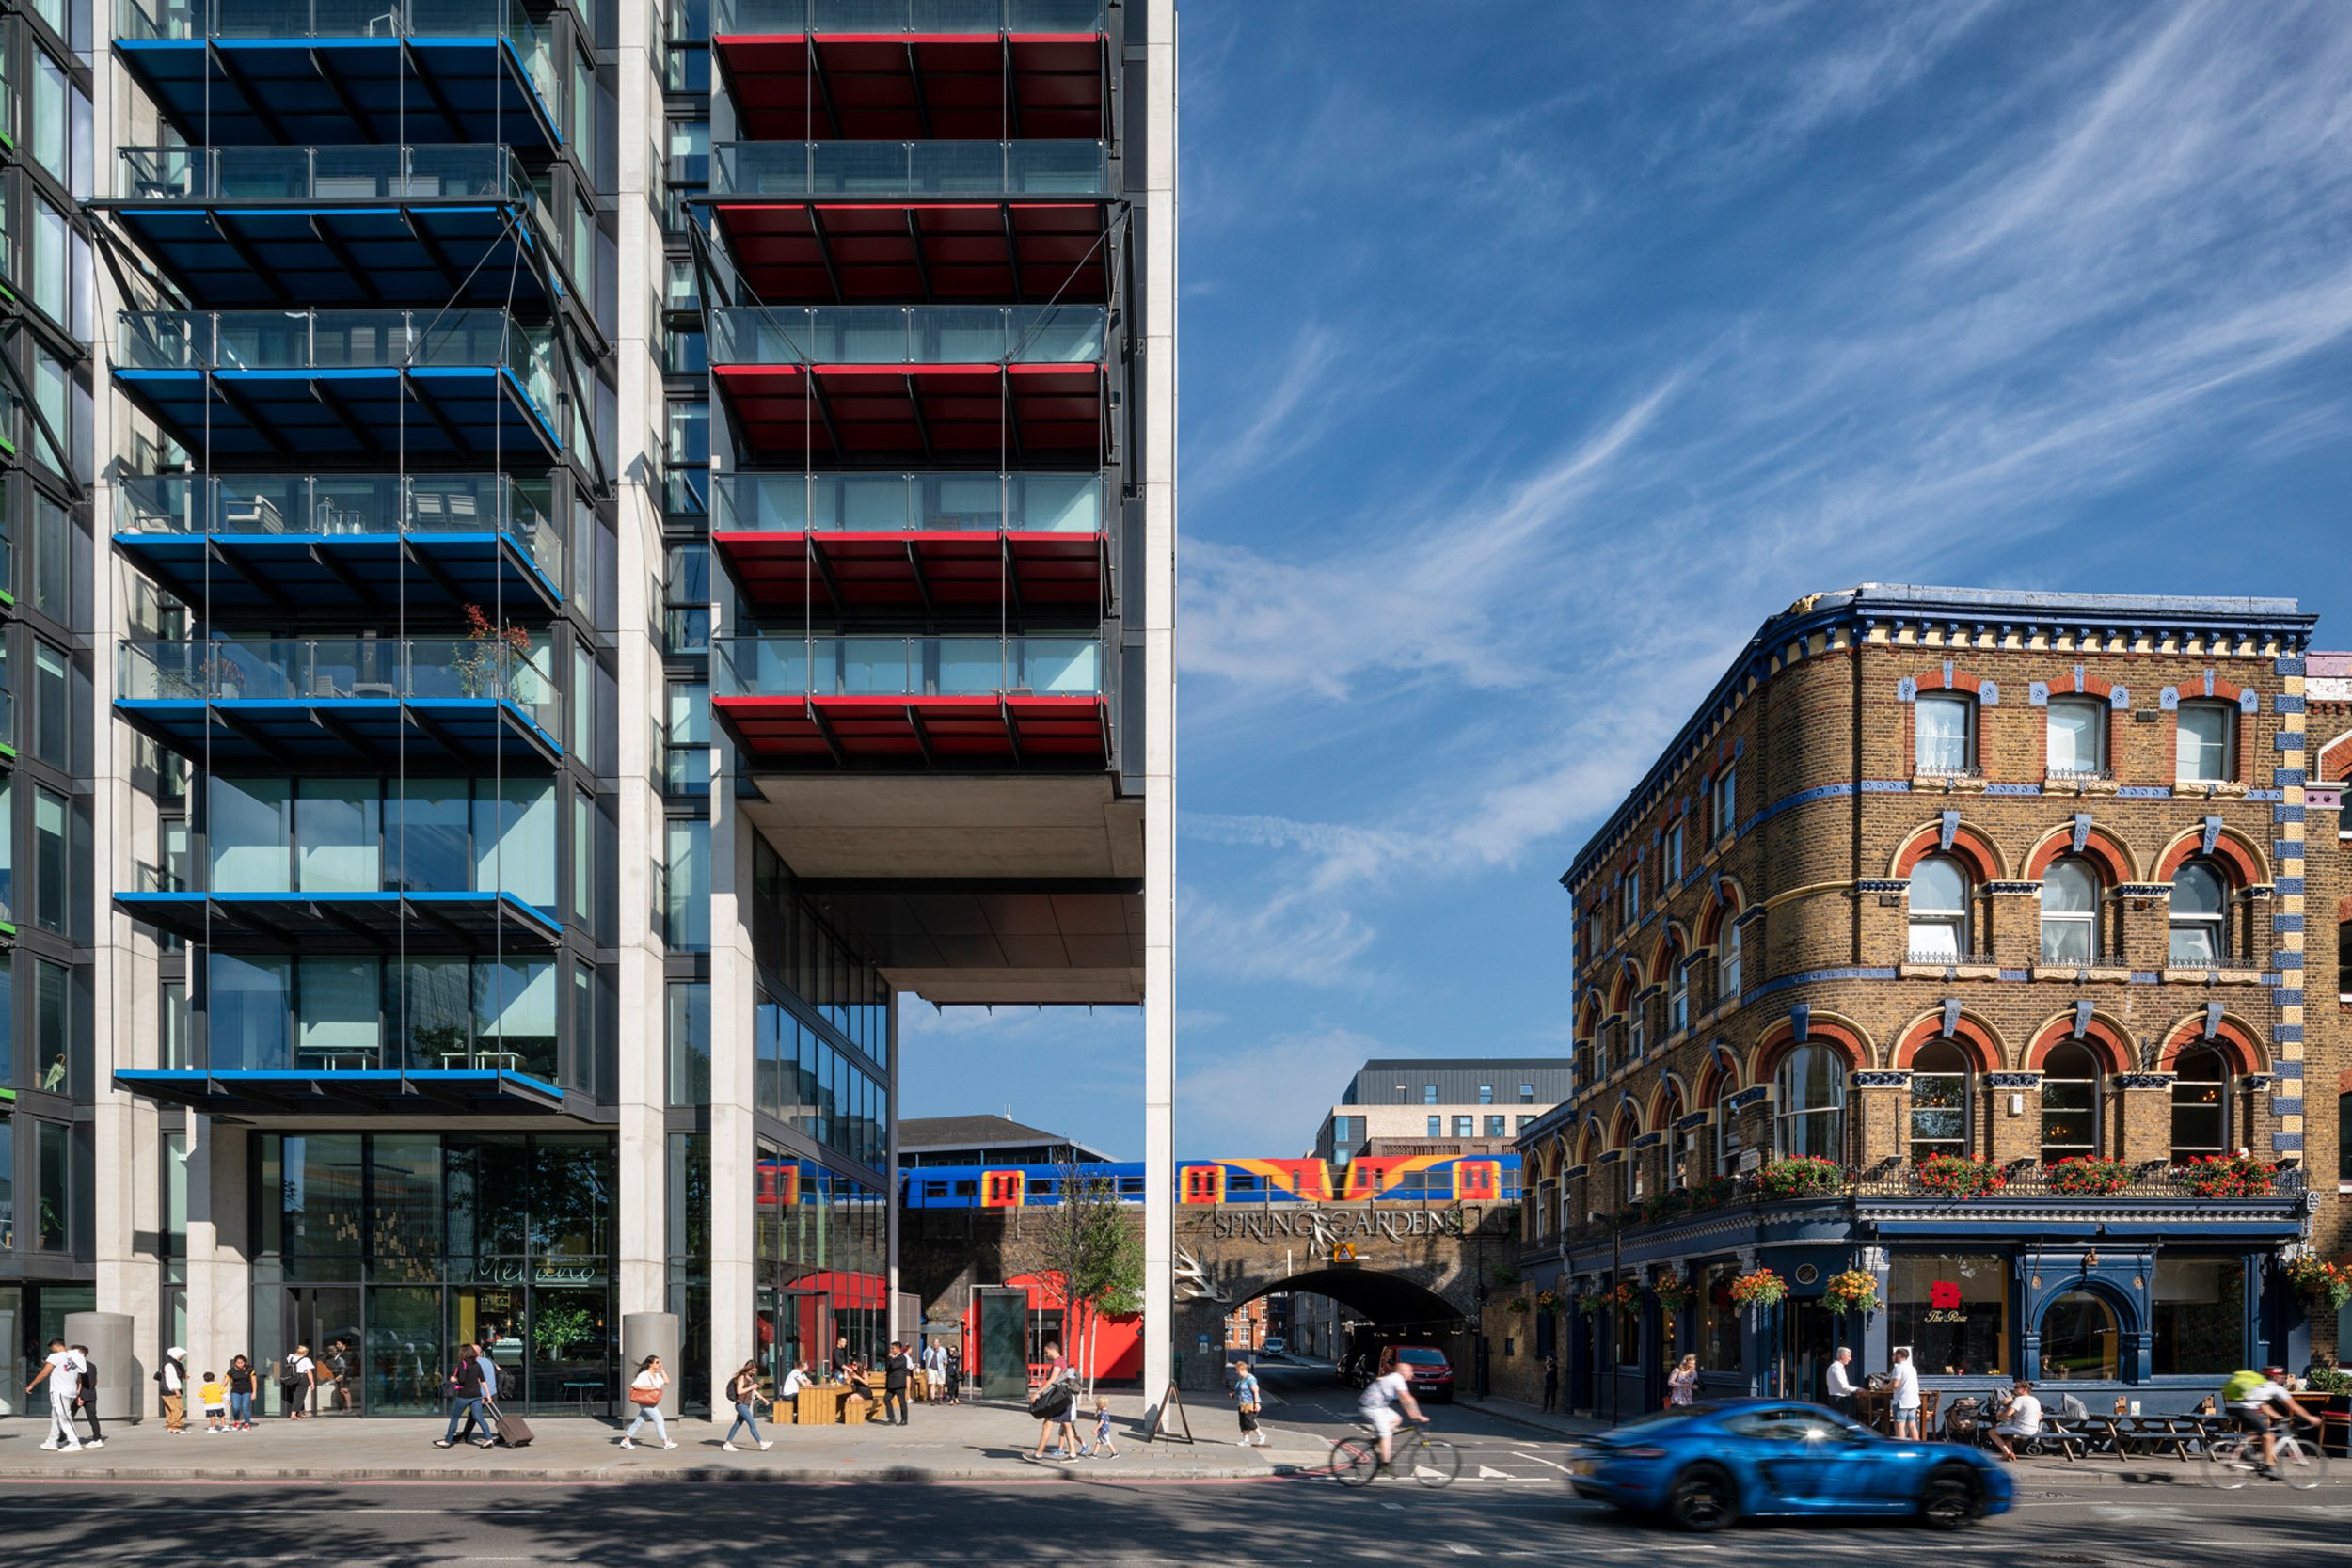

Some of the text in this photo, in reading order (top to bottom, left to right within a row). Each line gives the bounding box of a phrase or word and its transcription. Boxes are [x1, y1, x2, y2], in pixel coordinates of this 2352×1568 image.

[1216, 1210, 1462, 1243] SPRING GARDENS
[1924, 1310, 1968, 1323] The Rose
